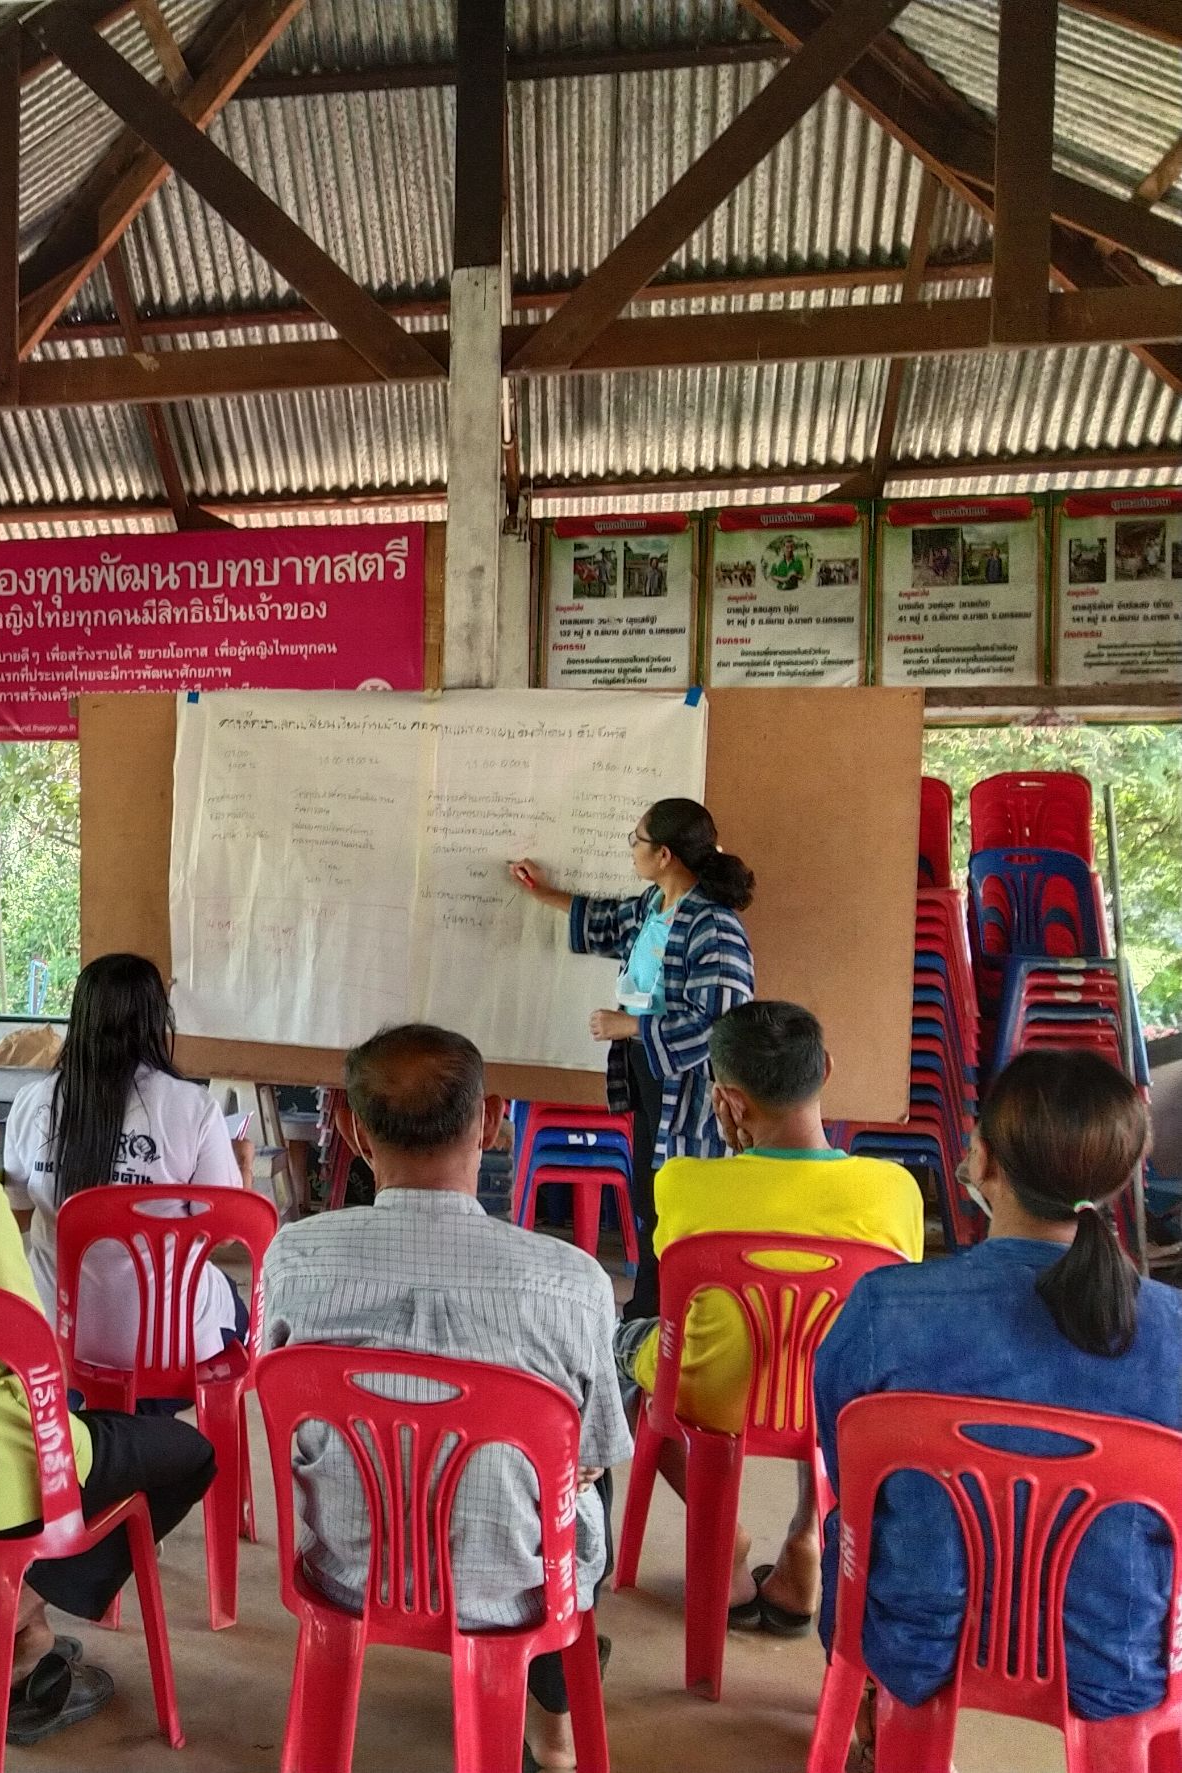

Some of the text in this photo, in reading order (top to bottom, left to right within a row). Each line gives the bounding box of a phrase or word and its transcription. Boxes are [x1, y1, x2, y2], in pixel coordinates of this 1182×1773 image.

[47, 643, 133, 662] เพื่อสร้างรายได้
[139, 642, 208, 660] ขยายโอกาส
[215, 637, 337, 662] เพื่อผู้หญิงไทยทุกคน
